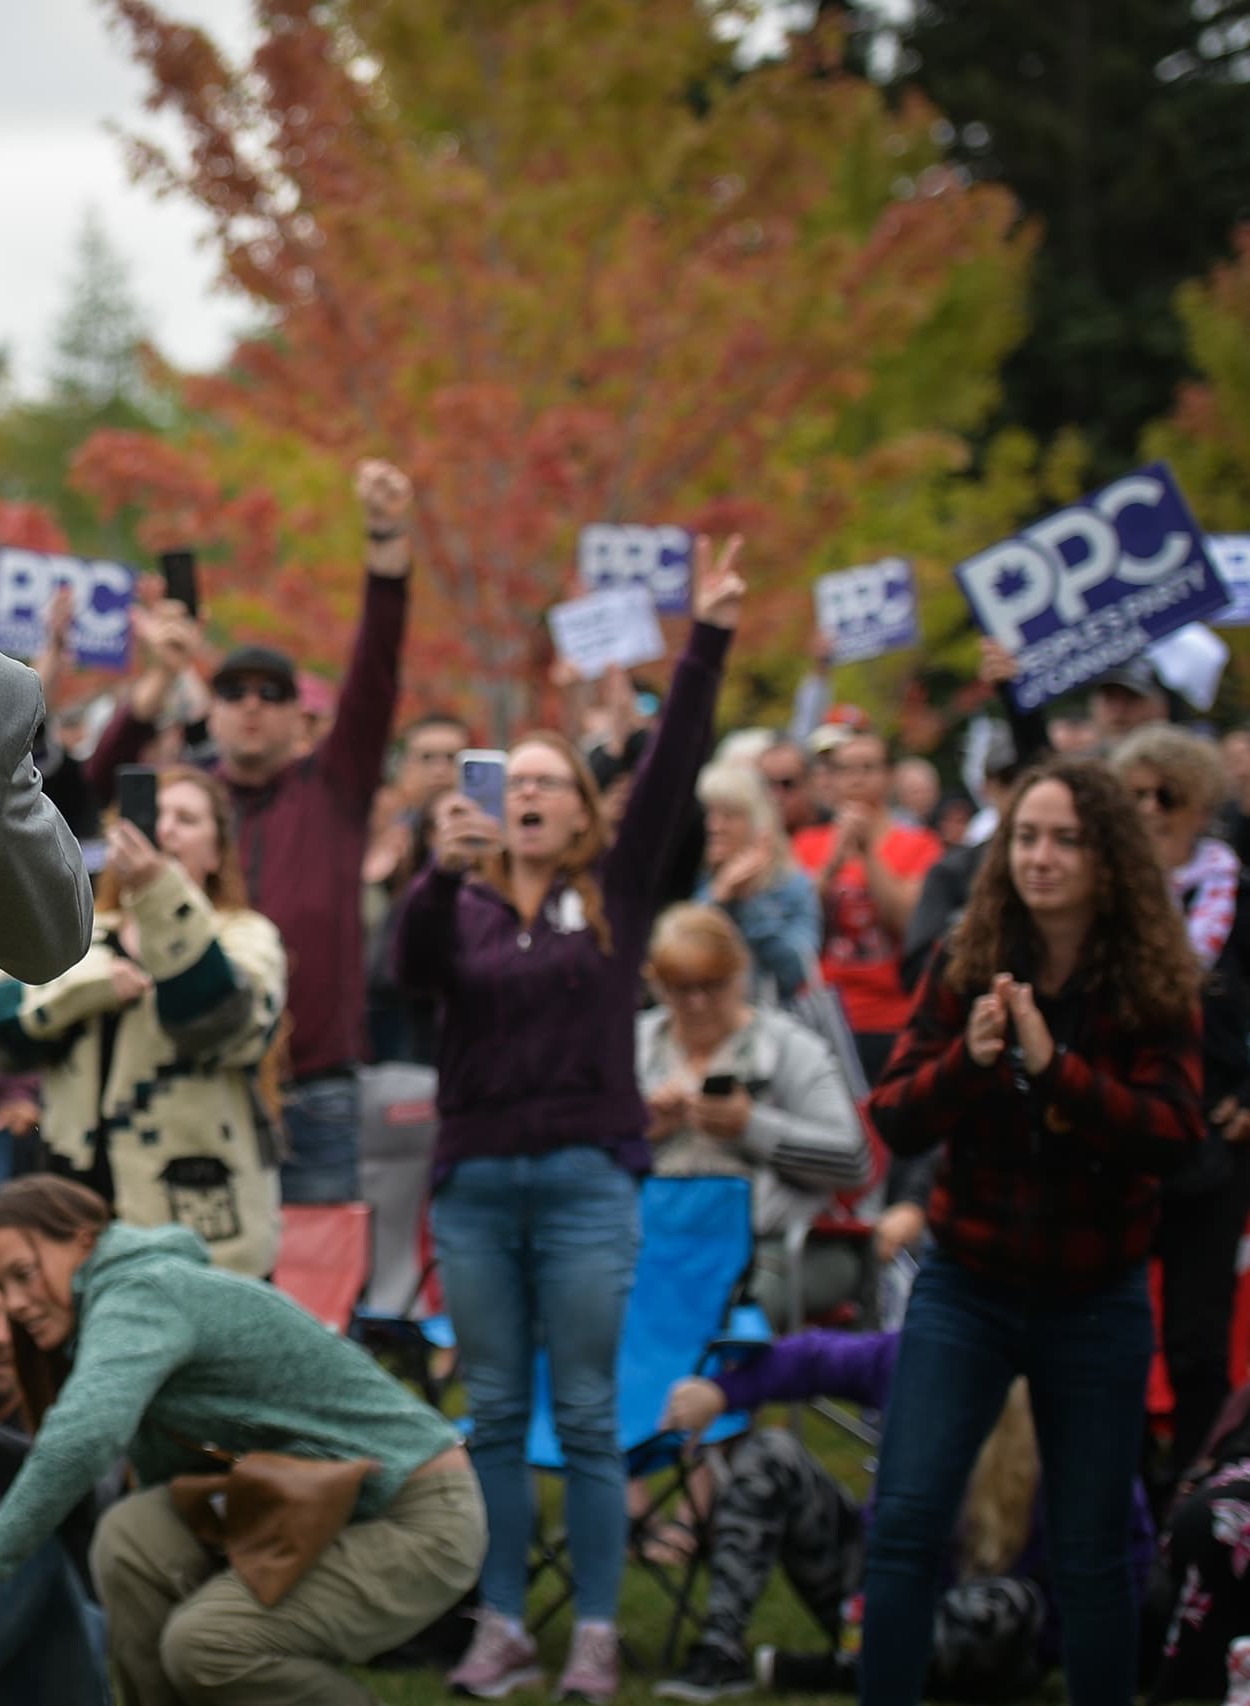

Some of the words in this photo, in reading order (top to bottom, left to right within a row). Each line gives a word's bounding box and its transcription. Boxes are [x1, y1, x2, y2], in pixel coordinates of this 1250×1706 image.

[578, 523, 690, 588] PPC
[962, 475, 1192, 649] PPC
[816, 558, 913, 636] PPC
